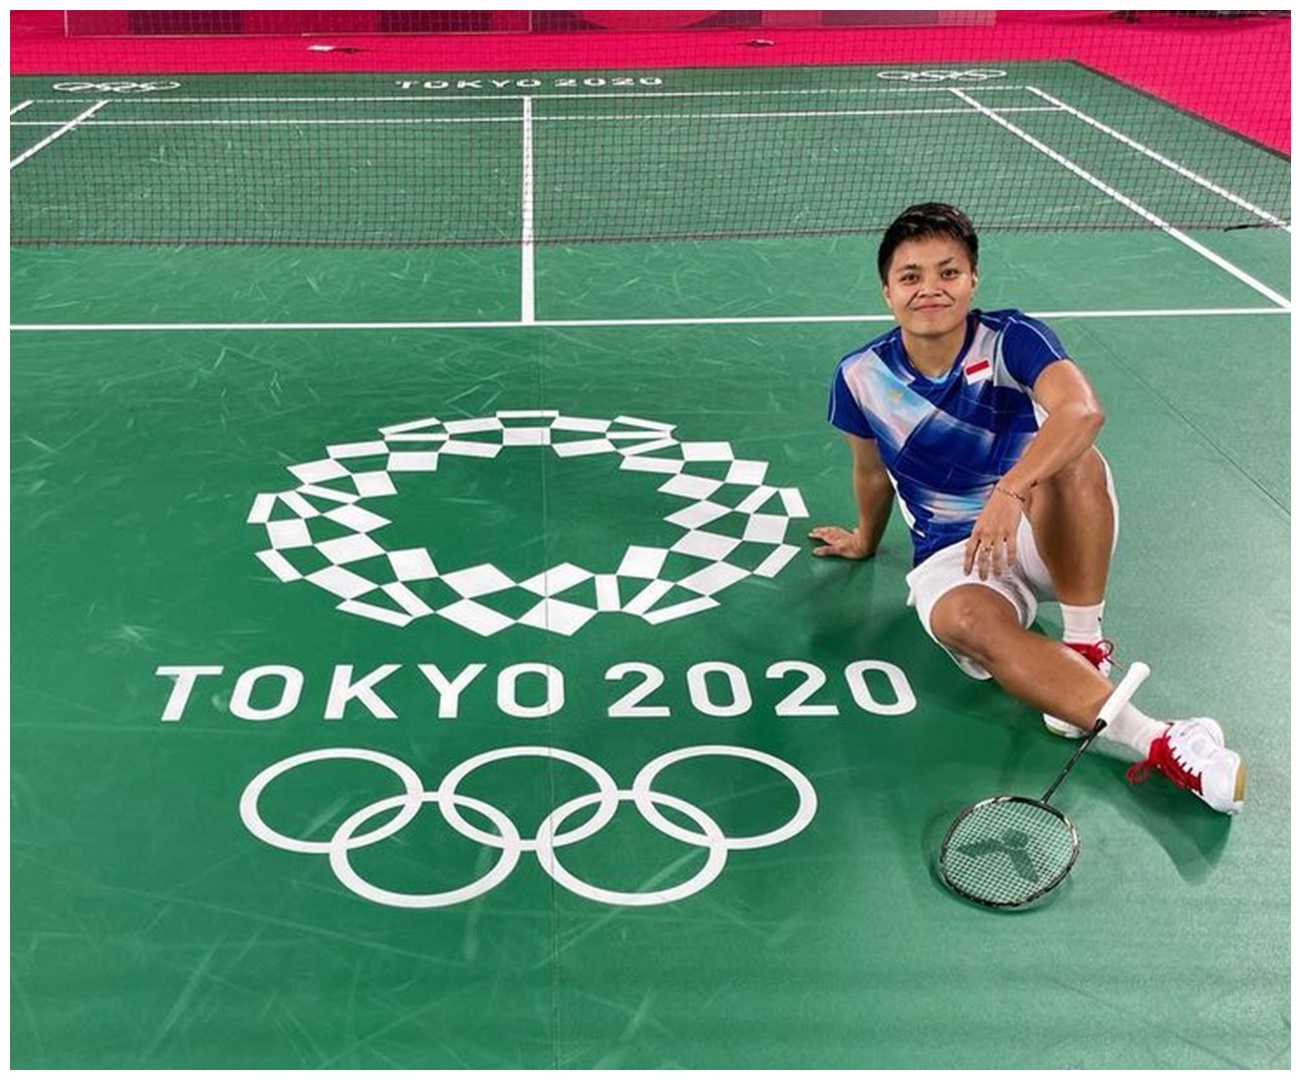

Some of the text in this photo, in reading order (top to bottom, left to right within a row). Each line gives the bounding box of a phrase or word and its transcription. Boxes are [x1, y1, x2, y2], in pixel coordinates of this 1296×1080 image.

[396, 76, 663, 89] TOKYO 2020
[156, 660, 917, 721] TOKYO 2020
